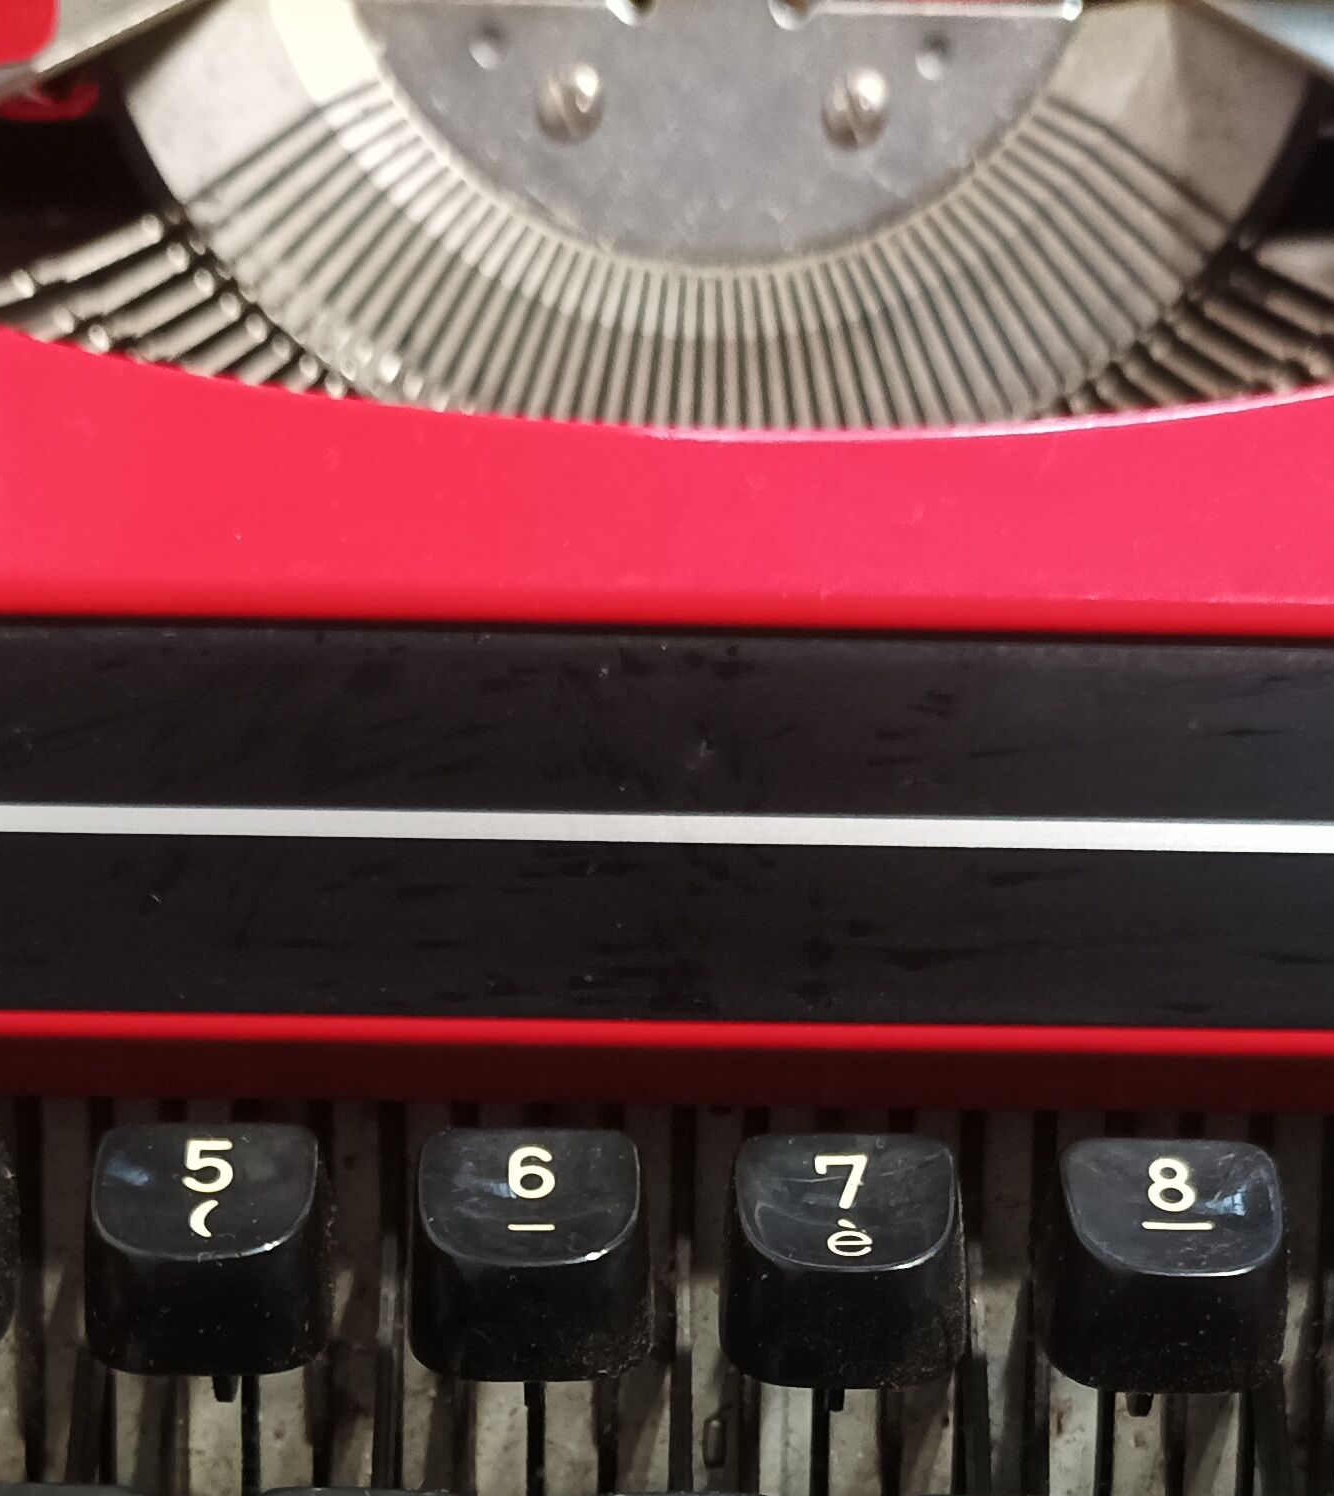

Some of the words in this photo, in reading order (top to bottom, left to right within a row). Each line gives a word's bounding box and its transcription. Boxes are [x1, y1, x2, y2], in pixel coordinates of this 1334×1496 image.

[182, 1139, 234, 1193] 5
[499, 1146, 556, 1199] 6
[814, 1154, 868, 1210] 7
[1147, 1157, 1196, 1212] 8
[826, 1218, 873, 1257] è
